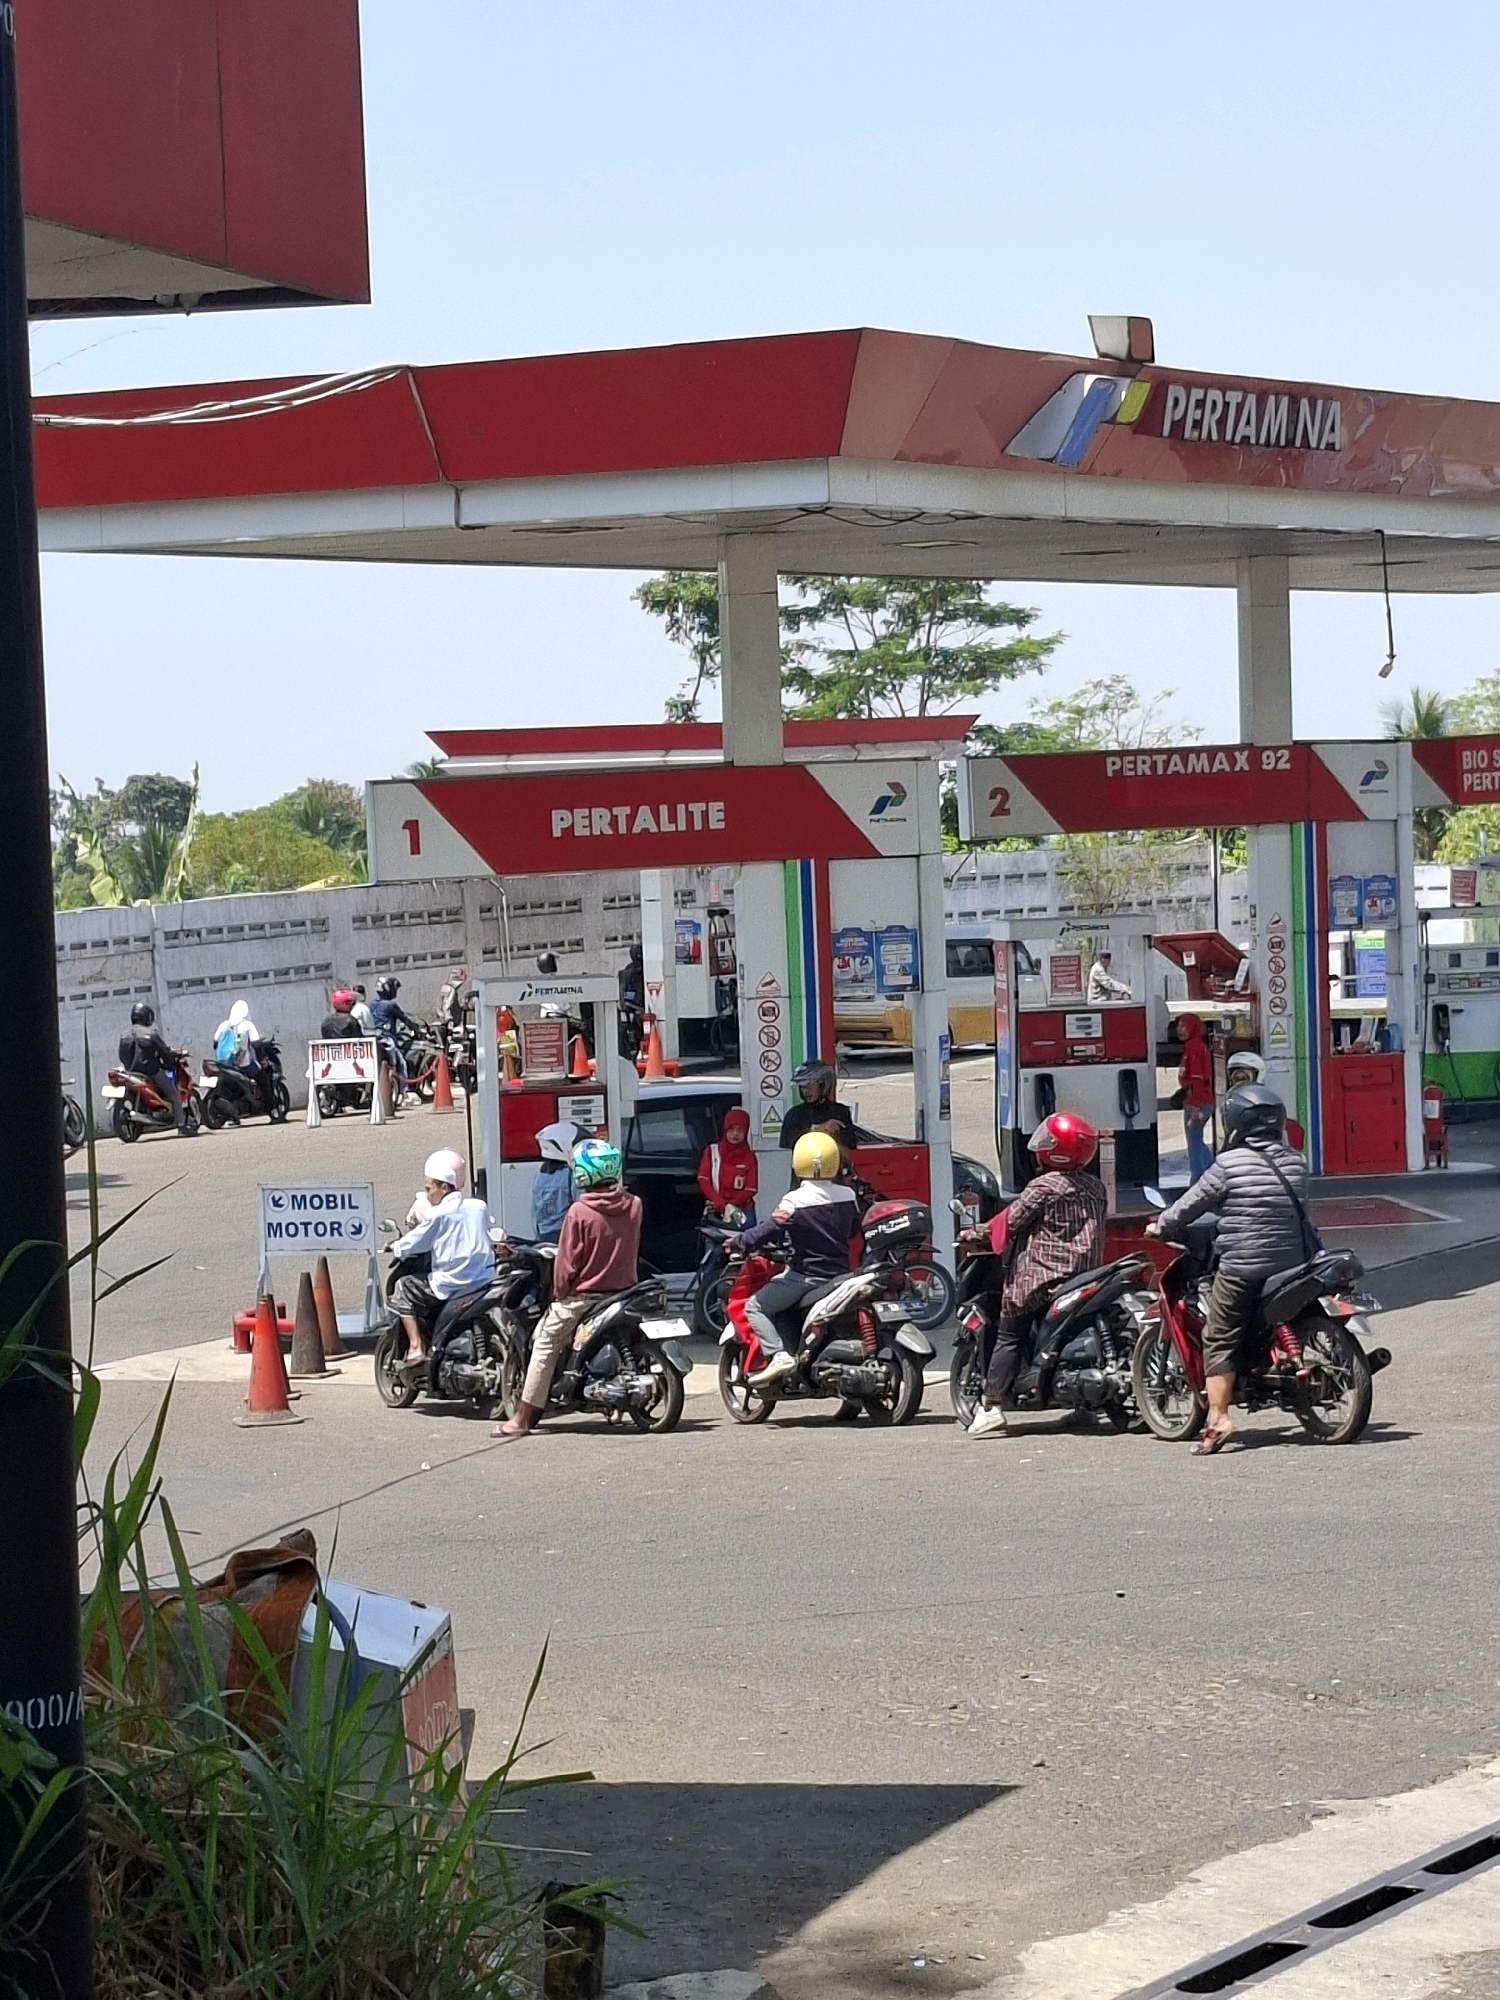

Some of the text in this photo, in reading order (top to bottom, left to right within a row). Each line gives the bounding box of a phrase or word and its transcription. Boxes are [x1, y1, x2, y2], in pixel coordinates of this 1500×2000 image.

[1162, 383, 1341, 451] PERTAMNA
[1105, 750, 1291, 777] PERTAMAX 92
[1462, 750, 1488, 770] BIO
[1463, 771, 1500, 793] PERT
[988, 787, 1011, 818] 2
[551, 801, 726, 838] PERTALITE
[402, 819, 420, 855] 1
[291, 1194, 360, 1211] MOBIL
[267, 1221, 344, 1238] MOTOR
